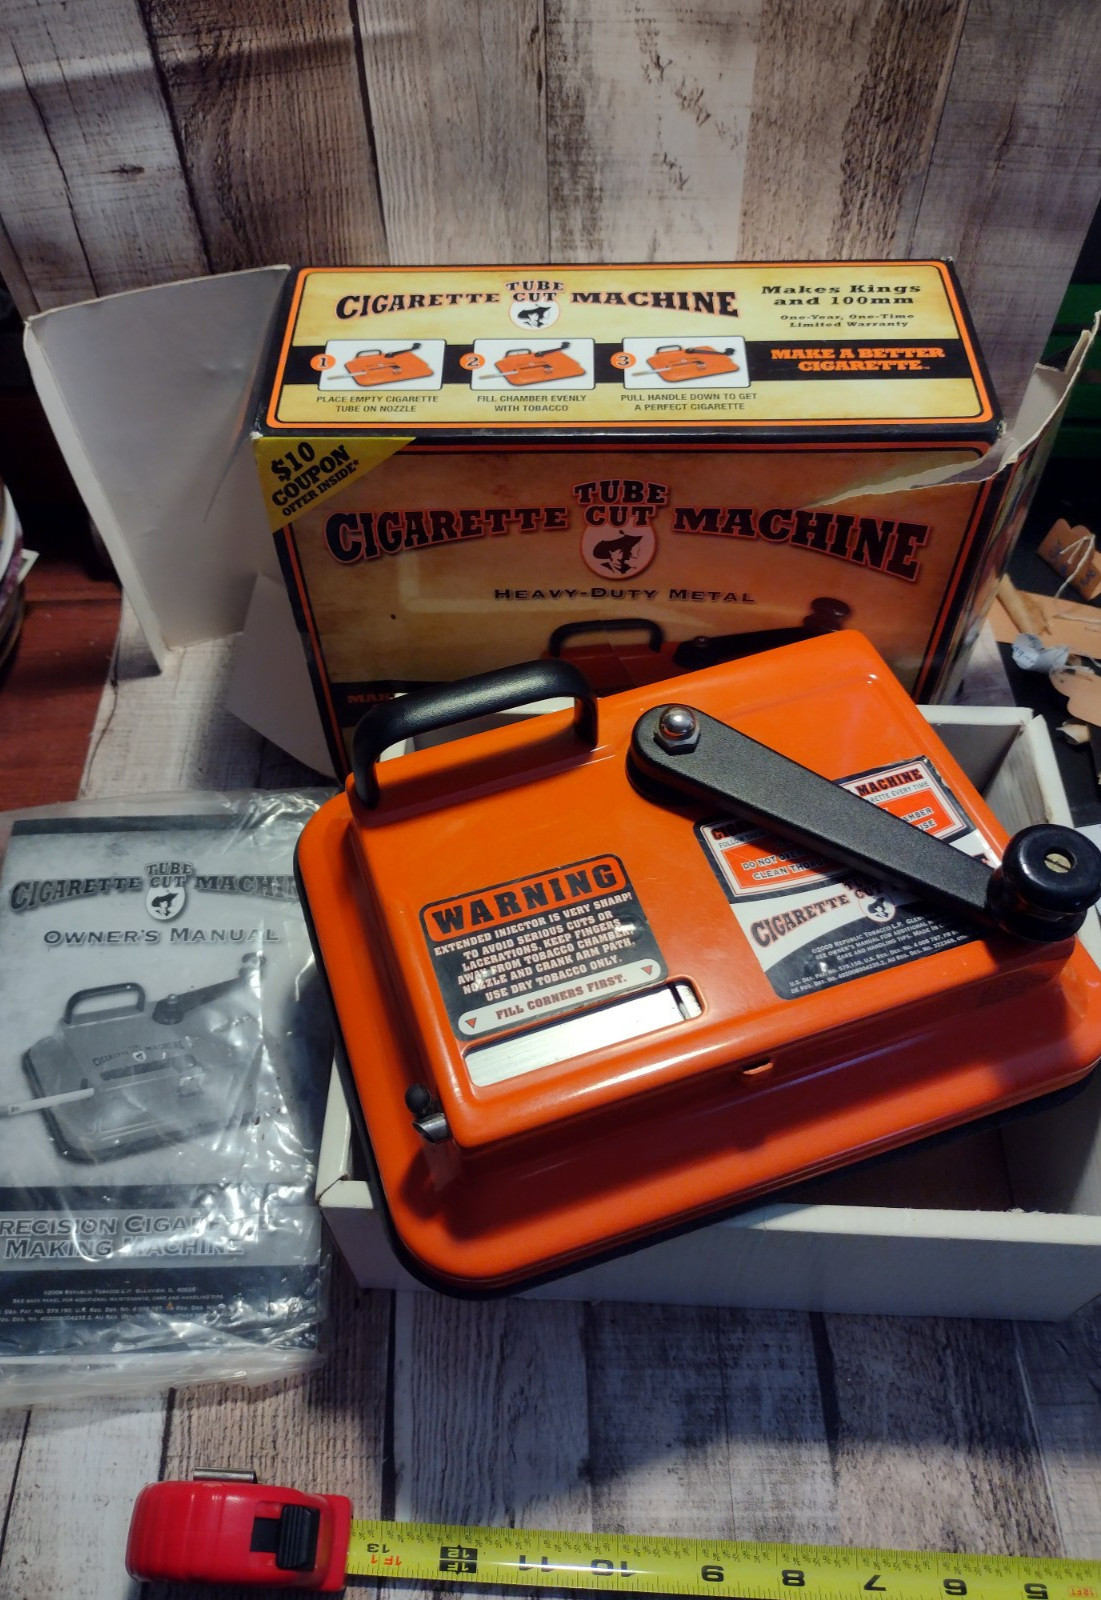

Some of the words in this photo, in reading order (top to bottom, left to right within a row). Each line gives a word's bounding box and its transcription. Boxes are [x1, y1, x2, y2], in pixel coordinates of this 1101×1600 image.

[505, 280, 564, 292] TUBE
[761, 285, 841, 294] Makes
[850, 284, 921, 295] Kings
[335, 291, 500, 320] CIGARETTE
[512, 292, 558, 303] CUT
[570, 291, 739, 318] MACHINE
[773, 297, 822, 305] and
[831, 296, 914, 305] 100mm
[780, 313, 844, 321] One-Year,
[789, 321, 841, 329] Limited
[847, 321, 909, 329] Warranty
[318, 356, 328, 368] 1
[467, 356, 479, 367] 2
[617, 355, 629, 366] 3
[770, 348, 836, 360] MAKE
[839, 349, 855, 359] A
[858, 347, 946, 359] BETTER
[316, 395, 348, 403] PLACE
[350, 395, 384, 403] EMPTY
[385, 394, 439, 403] CIGARETTE
[477, 394, 498, 402] FILL
[499, 394, 548, 403] CHAMBER
[549, 394, 587, 402] EVENLY
[620, 393, 646, 402] PULL
[649, 393, 687, 401] HANDLE
[689, 393, 721, 401] DOWN
[739, 392, 757, 400] GET
[336, 405, 361, 413] TUBE
[363, 405, 377, 413] ON
[379, 405, 417, 413] NOZZLE
[494, 404, 520, 412] WITH
[522, 404, 569, 412] TOBACCO
[634, 403, 642, 411] A
[643, 402, 688, 411] PERFECT
[690, 402, 745, 411] CIGARETTE
[270, 441, 316, 482] $10
[271, 444, 351, 507] COUPON
[574, 480, 667, 505] TUBE
[282, 489, 317, 518] OFFER
[584, 506, 655, 526] CUT
[325, 507, 568, 563] CIGARETTE
[673, 507, 930, 582] MACHINE
[494, 587, 656, 600] HEAVY-DUTY
[669, 588, 755, 603] METAL
[855, 768, 924, 797] MACHINE
[891, 787, 913, 797] EVERY
[913, 781, 930, 790] TIME
[147, 862, 193, 876] TUBE
[742, 861, 756, 870] DO
[758, 855, 777, 867] NOT
[149, 876, 187, 888] CUT
[752, 867, 788, 880] CLEAN
[10, 876, 143, 911] CIGARETTE
[431, 864, 617, 935] WARNING
[434, 932, 493, 956] EXTENDED
[494, 916, 547, 939] INJECTOR
[548, 912, 561, 923] IS
[562, 904, 590, 919] VERY
[593, 892, 633, 910] SHARP!
[749, 894, 851, 947] CIGARETTE
[43, 929, 160, 945] OWNER'S
[170, 927, 280, 943] MANUAL
[463, 949, 479, 960] TO
[482, 938, 515, 955] AVOID
[516, 925, 564, 945] SERIOUS
[566, 915, 596, 931] CUTS
[597, 910, 614, 921] OR
[834, 934, 864, 947] REPUBLIC
[863, 925, 892, 938] TOBACCO
[855, 937, 880, 948] MANUAL
[462, 943, 542, 973] LACERATIONS,
[542, 933, 572, 949] KEEP
[574, 918, 622, 939] FINGERS
[457, 968, 488, 985] AWAY
[490, 959, 522, 975] FROM
[523, 943, 575, 965] TOBACCO
[462, 974, 508, 995] NOZZLE
[510, 967, 533, 981] AND
[535, 955, 574, 973] CRANK
[575, 947, 600, 961] ARM
[602, 937, 636, 953] PATH.
[485, 987, 509, 1002] USE
[510, 980, 533, 994] DRY
[535, 964, 587, 986] TOBACCO
[590, 955, 623, 970] ONLY.
[495, 1004, 525, 1020] FILL
[527, 986, 584, 1011] CORNERS
[586, 973, 628, 993] FIRST.
[4, 1238, 114, 1259] MAKING
[366, 1543, 390, 1553] 13
[447, 1548, 470, 1559] 12
[383, 1555, 402, 1567] 1F
[447, 1561, 470, 1571] 1F
[518, 1554, 554, 1572] 11
[590, 1559, 636, 1577] 10
[701, 1565, 725, 1583] 9
[781, 1569, 805, 1587] 8
[863, 1575, 887, 1592] 7
[943, 1578, 968, 1596] 6
[1024, 1583, 1049, 1599] 5
